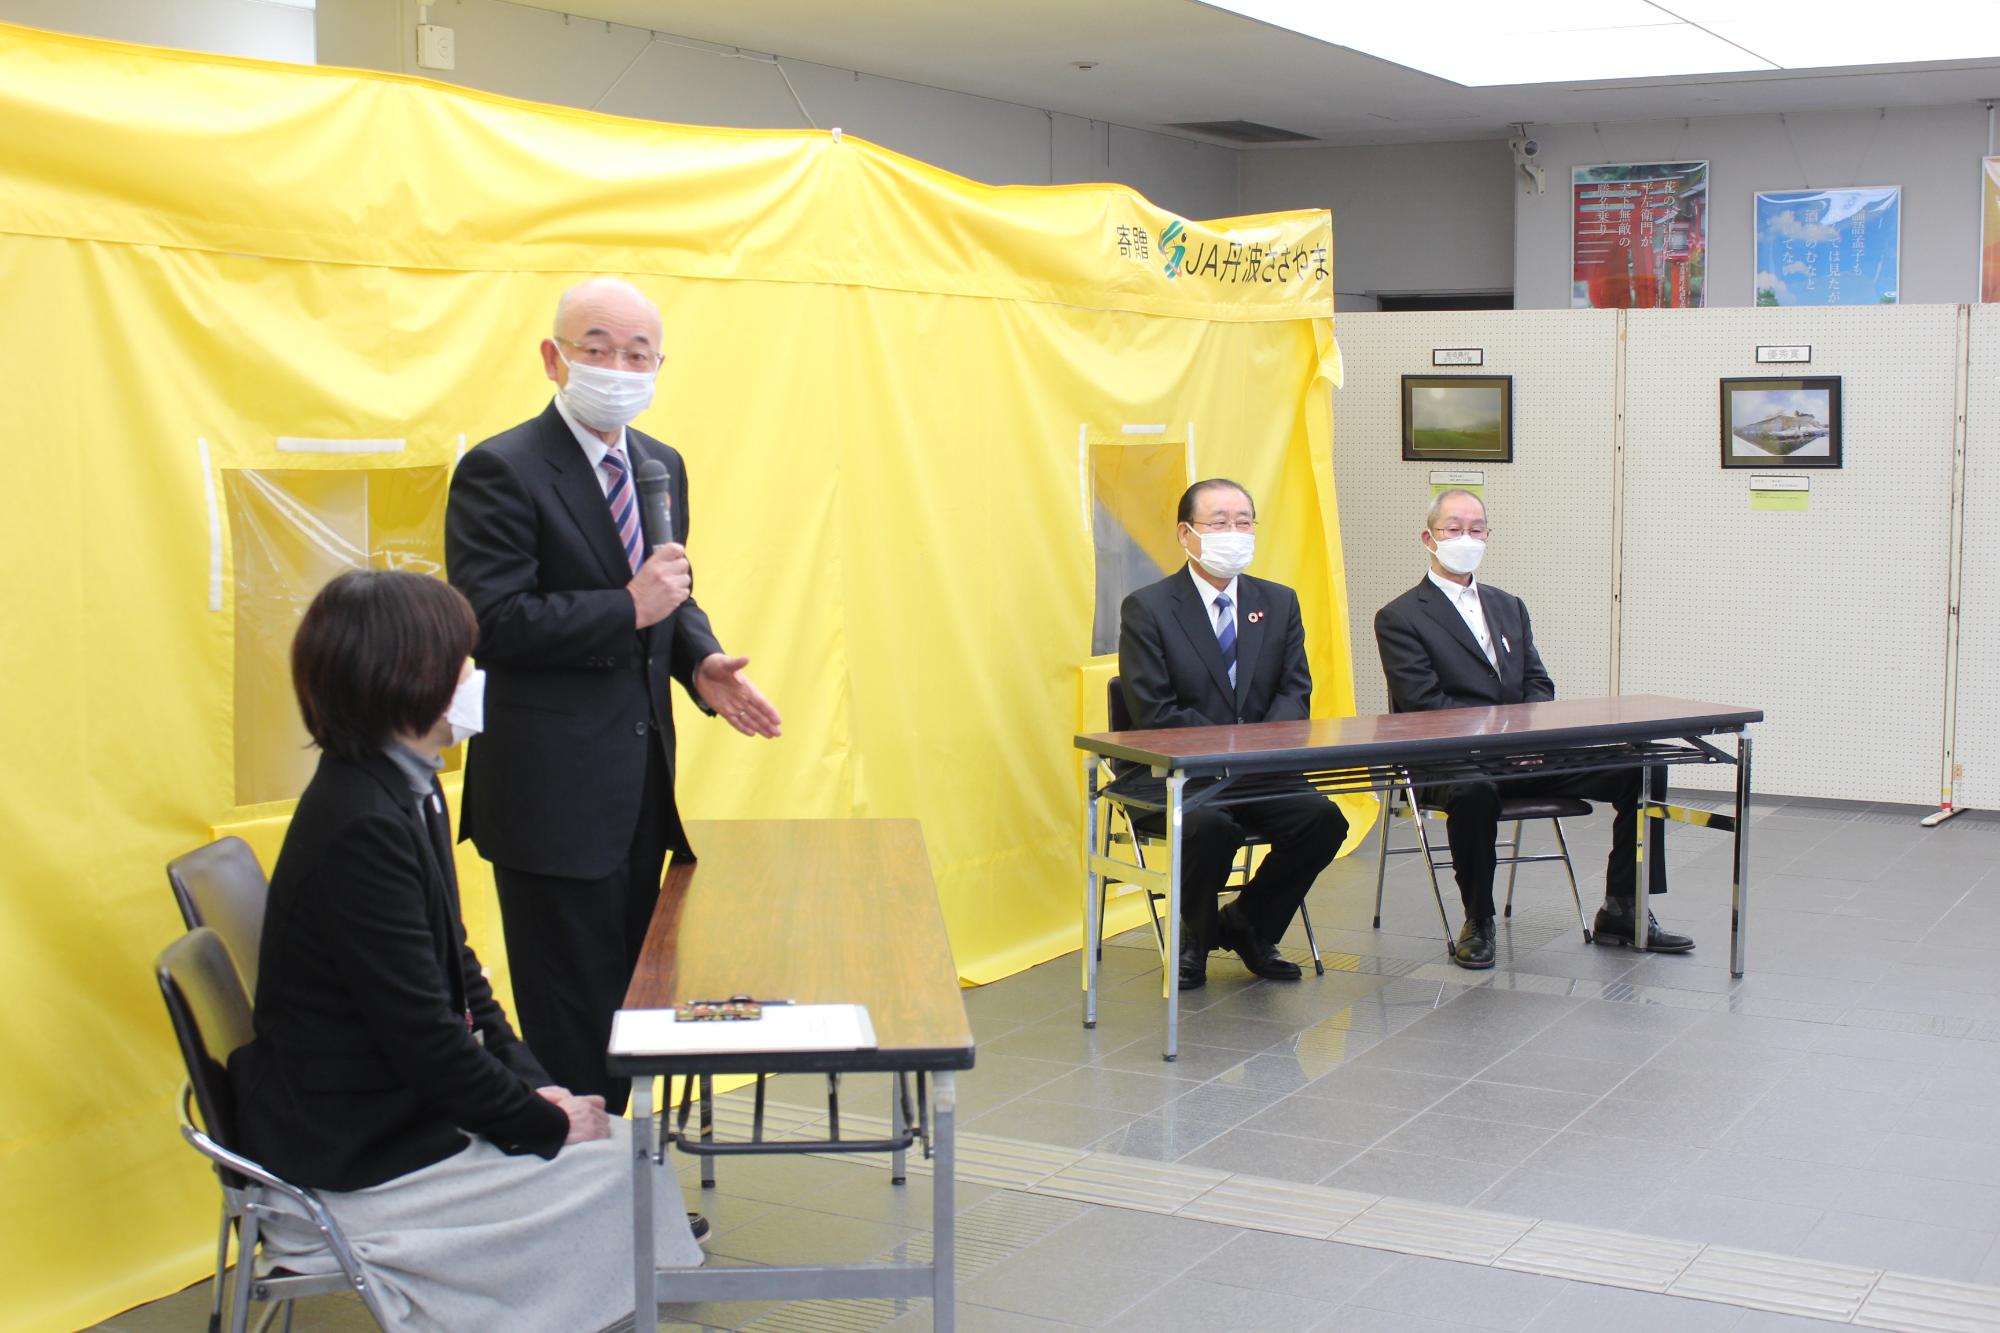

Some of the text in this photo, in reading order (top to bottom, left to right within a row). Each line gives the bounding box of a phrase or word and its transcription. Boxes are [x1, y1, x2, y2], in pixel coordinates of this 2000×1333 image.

[1597, 184, 1610, 237] 勝名乗り
[1618, 183, 1632, 248] 天下無敵の
[1640, 181, 1654, 248] 平左衛門が
[1116, 224, 1330, 284] 寄贈 JA丹波ささやま
